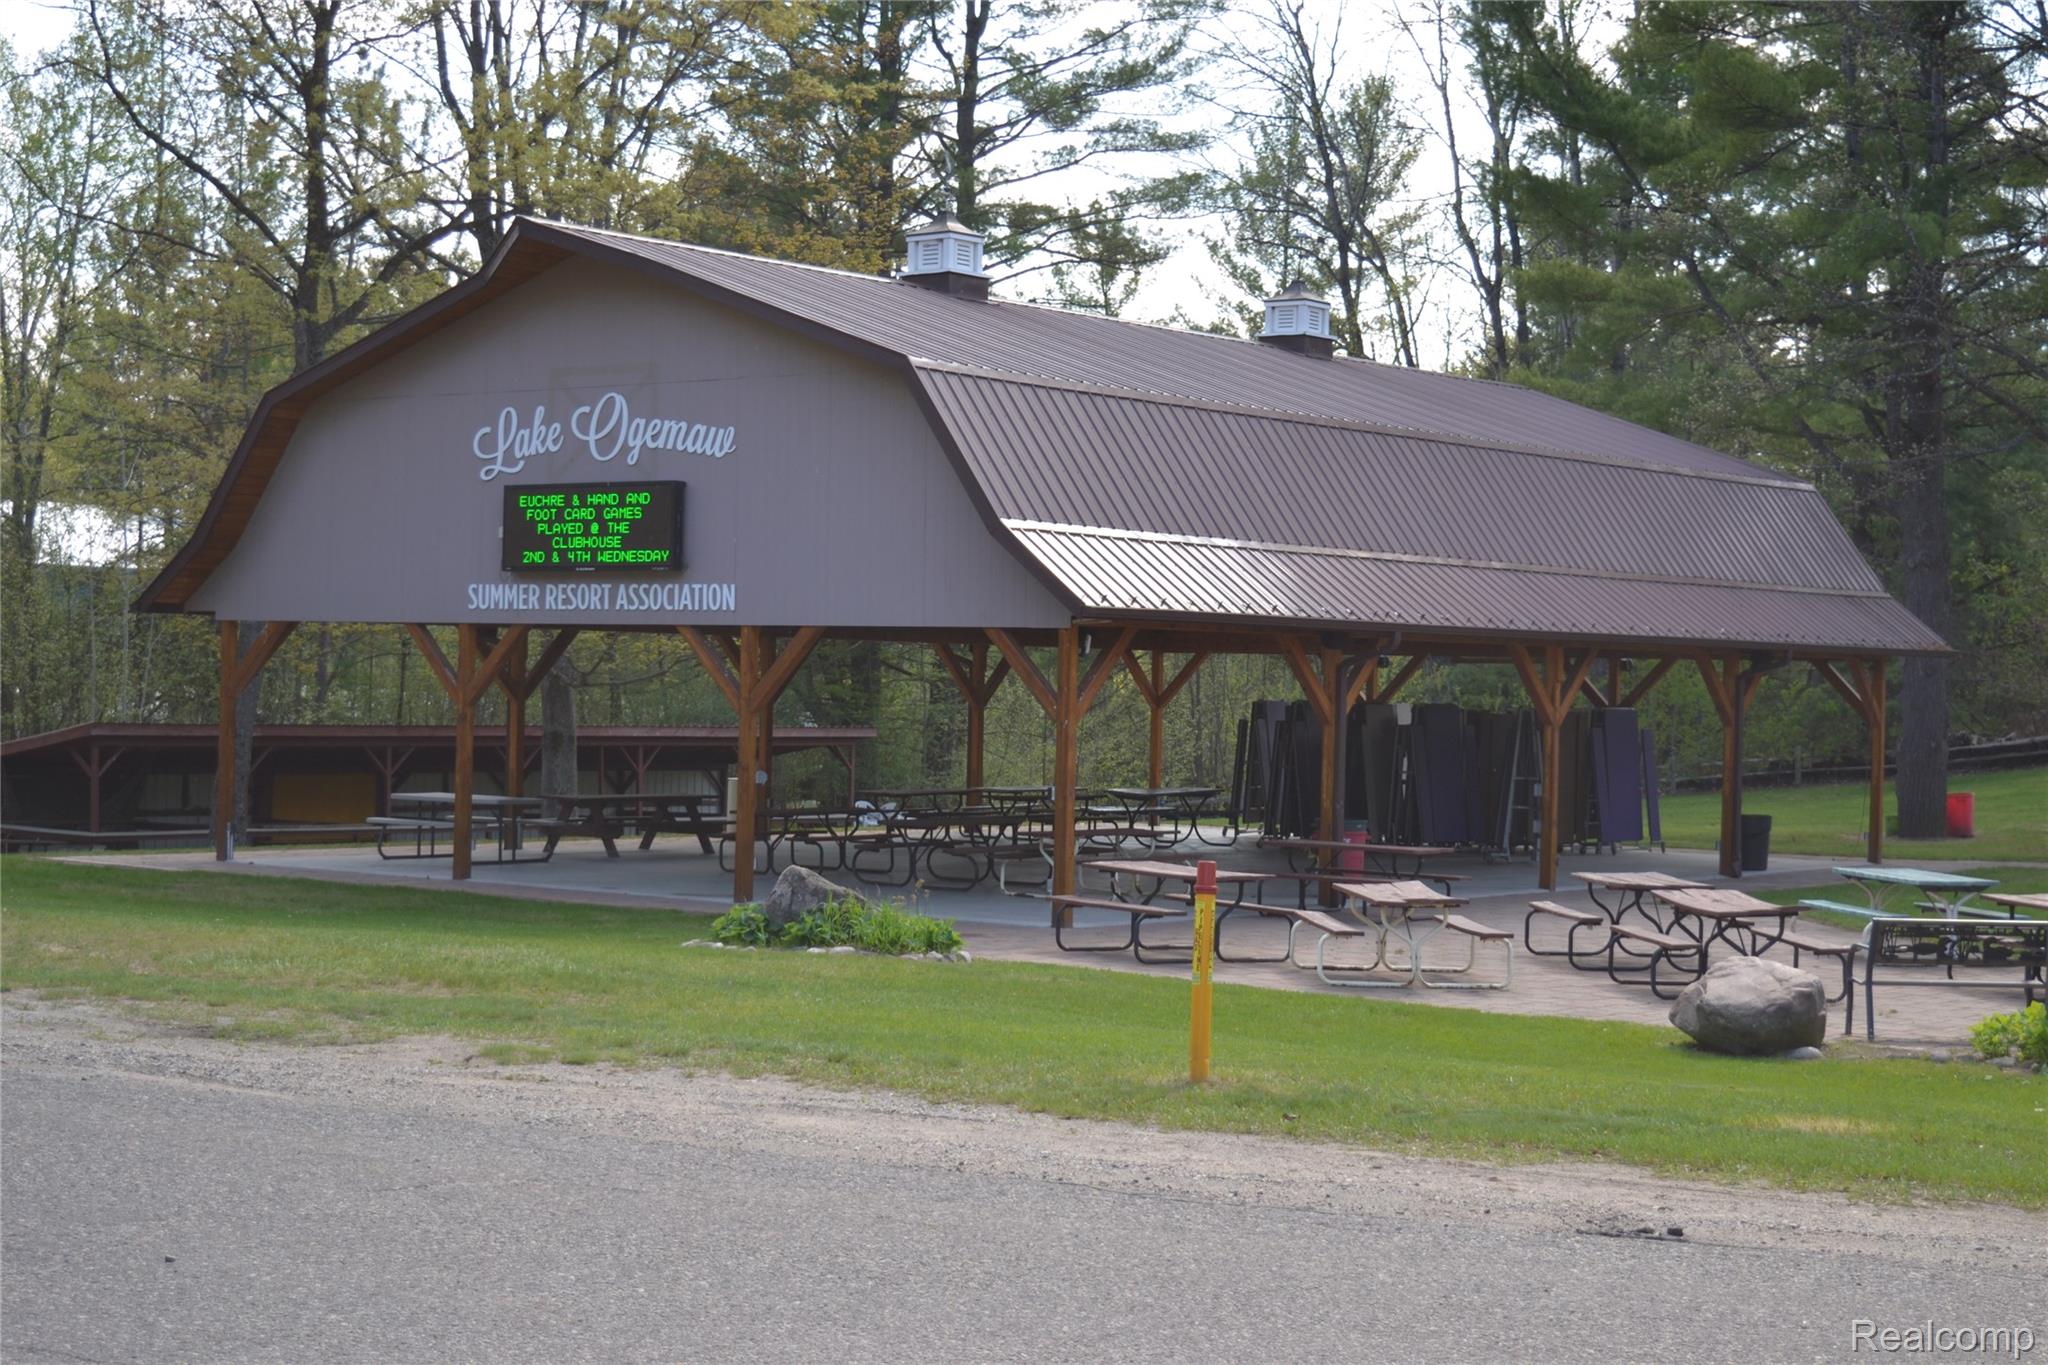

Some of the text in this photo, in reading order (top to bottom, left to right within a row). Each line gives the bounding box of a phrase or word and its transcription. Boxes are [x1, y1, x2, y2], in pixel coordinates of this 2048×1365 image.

[473, 392, 736, 480] Lake Ogemaw
[519, 493, 651, 507] EUCHRE & HAND AND
[527, 507, 642, 521] FOOT CARD GAMES
[537, 522, 630, 535] PLAYED @ THE
[552, 536, 622, 549] CLUBHOUSE
[522, 550, 670, 563] 2ND & 4TH WEDNESDAY
[468, 584, 736, 611] SUMMER RESORT ASSOCIATION
